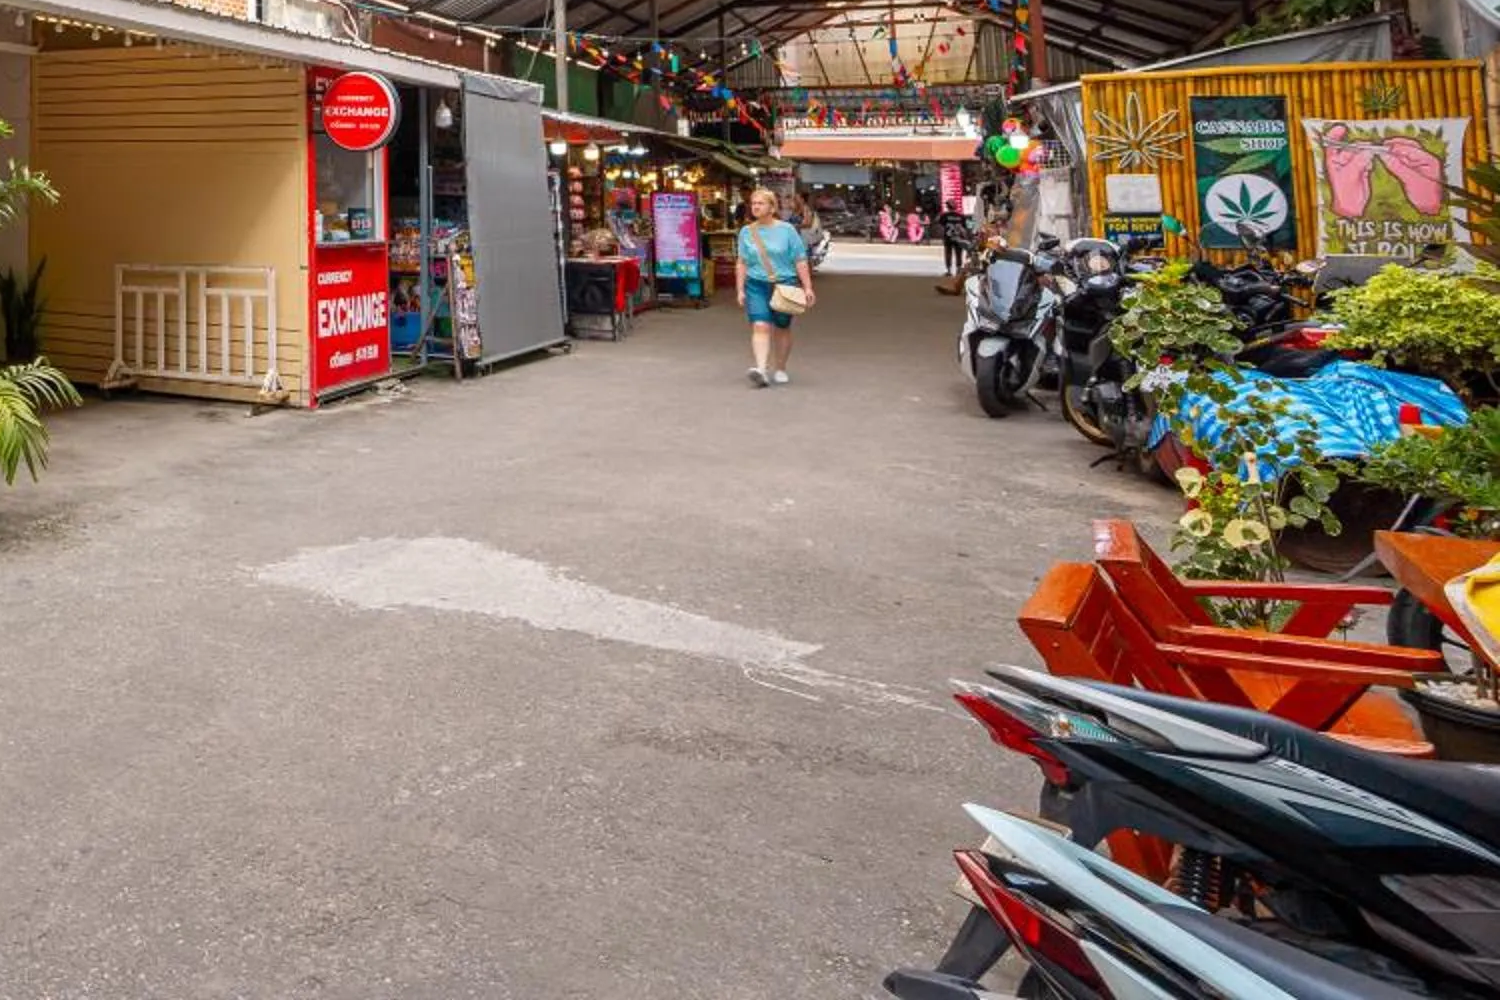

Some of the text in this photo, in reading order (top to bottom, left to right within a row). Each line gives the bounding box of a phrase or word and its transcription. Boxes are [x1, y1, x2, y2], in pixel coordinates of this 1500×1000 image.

[324, 105, 389, 117] EXCHANGE
[1195, 119, 1285, 135] CANNABIS
[1240, 137, 1287, 152] SHOP
[1336, 219, 1448, 245] THIS IS HOW
[318, 292, 387, 338] EXCHANGE
